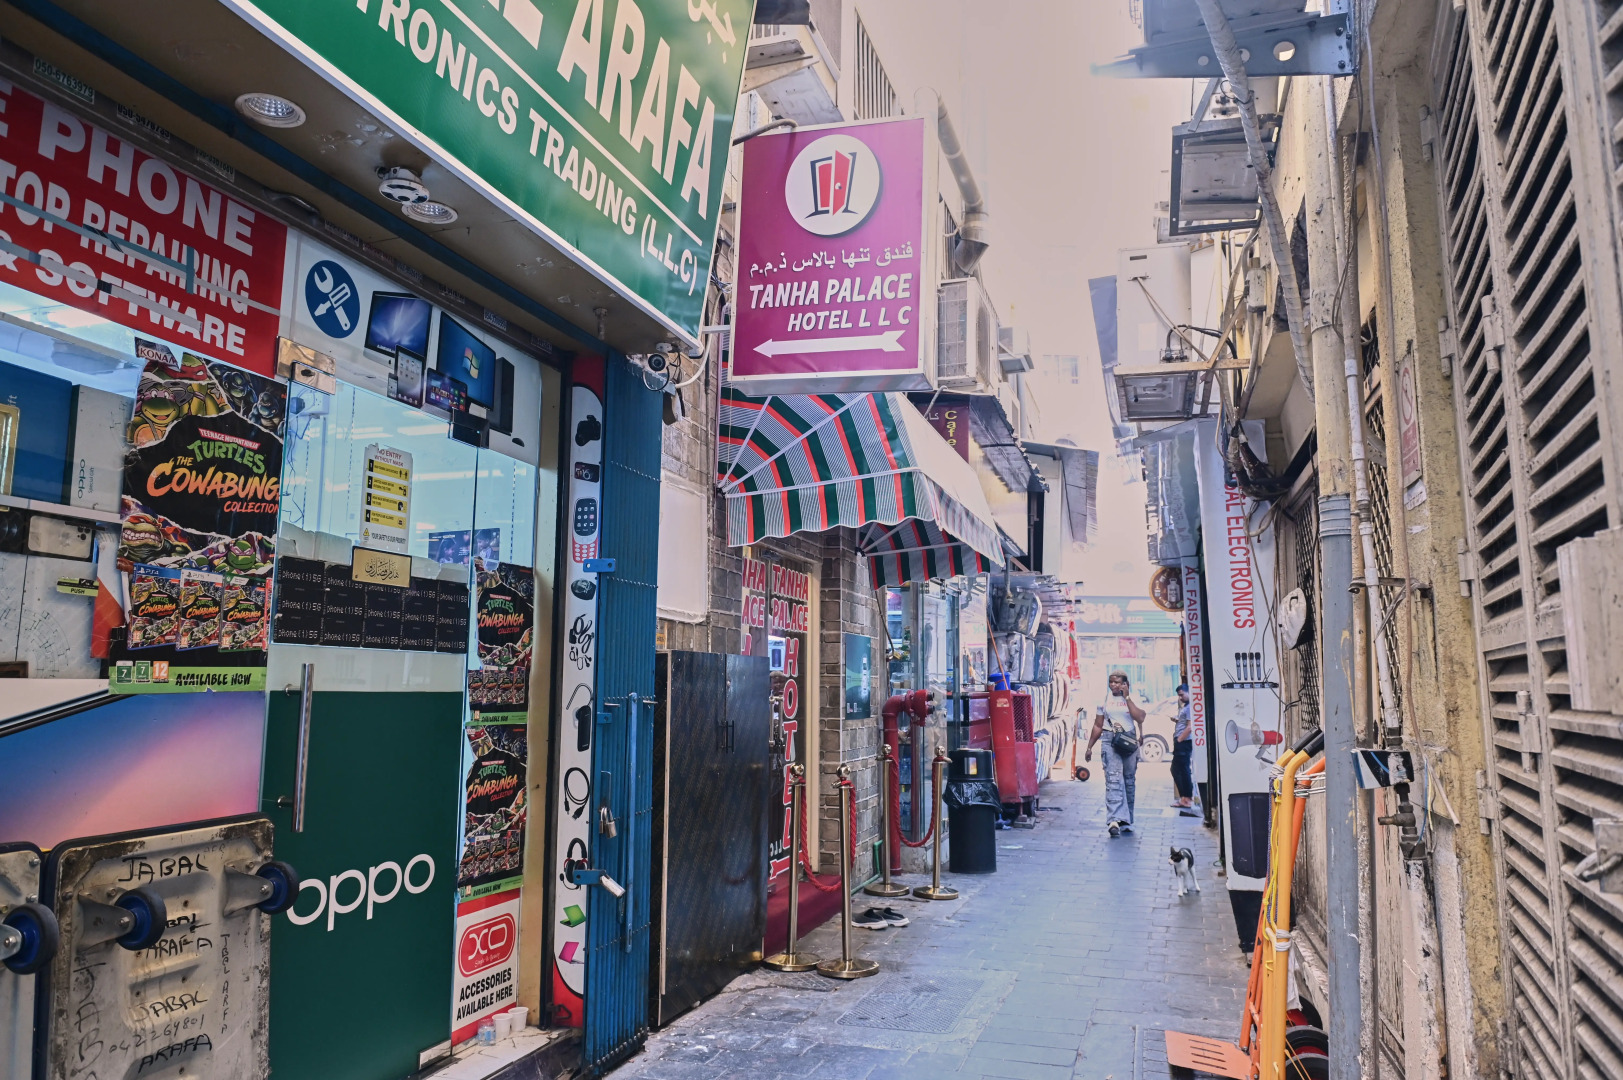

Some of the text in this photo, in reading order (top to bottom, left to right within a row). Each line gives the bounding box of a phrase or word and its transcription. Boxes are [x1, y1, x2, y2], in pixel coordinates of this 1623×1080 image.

[34, 58, 94, 98] 050-6763979
[556, 0, 715, 220] ARAFA
[356, 0, 519, 135] RONICS
[528, 108, 637, 235] TRADING
[640, 214, 698, 296] (L.L.C)
[38, 103, 255, 256] PHONE
[80, 198, 250, 315] REPAIRING
[792, 251, 836, 272] بالاس
[842, 247, 870, 269] تنها
[876, 241, 914, 268] فندق
[35, 248, 246, 356] SOFTWARE
[750, 273, 912, 309] TANHA PALACE
[788, 310, 852, 332] HOTEL
[200, 428, 260, 450] TEENAGE MUTANT NINJA
[944, 410, 957, 446] Cafe
[177, 456, 194, 467] THE
[187, 440, 266, 474] TURTLES
[374, 455, 392, 464] WITHOUT
[386, 450, 402, 460] ENTRY
[78, 458, 86, 500] oppo
[146, 458, 280, 500] COWABUNG
[772, 564, 808, 602] TANHA
[1226, 515, 1256, 629] ELECTRONICS
[70, 587, 85, 595] PUSH
[486, 599, 514, 612] TURTLES
[772, 600, 808, 633] PALACE
[154, 663, 168, 677] 12
[1184, 565, 1205, 746] AL FAISAL ELECTRONICS
[175, 673, 252, 686] AVAILABLE NOW
[478, 764, 507, 779] TURTLES
[286, 854, 436, 931] oppo
[468, 923, 508, 960] XO
[460, 967, 512, 1002] ACCESSORIES
[456, 984, 513, 1021] AVAILABLE HERE
